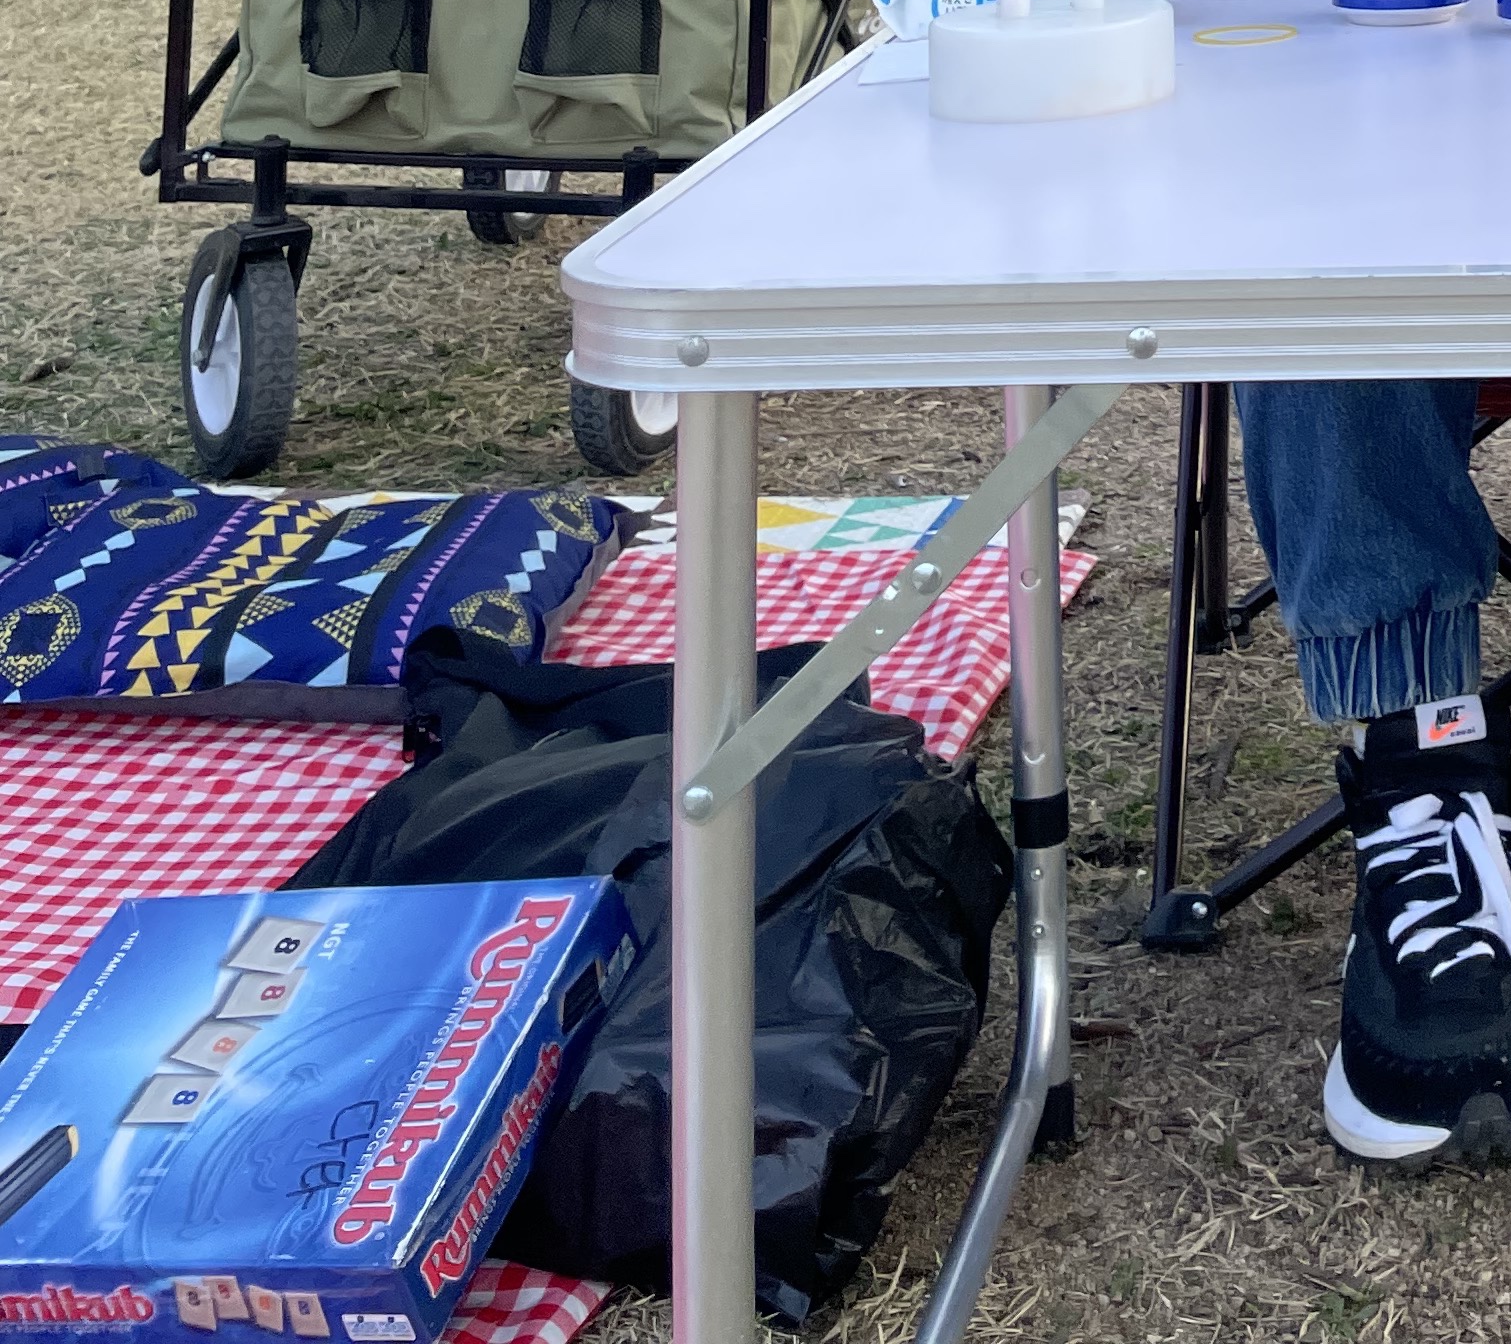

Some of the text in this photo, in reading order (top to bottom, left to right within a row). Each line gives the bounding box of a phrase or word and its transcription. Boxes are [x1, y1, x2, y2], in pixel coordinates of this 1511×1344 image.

[120, 929, 140, 951] THE
[274, 936, 301, 955] 8
[317, 922, 350, 961] NGT
[94, 952, 127, 988] FAMILY
[71, 987, 99, 1018] GAME
[260, 985, 286, 1001] 8
[44, 1018, 78, 1056] THAT'S
[212, 1036, 238, 1054] 8
[16, 1055, 50, 1092] NEVER
[332, 894, 574, 1246] Rummikub
[172, 1089, 199, 1106] 8
[331, 985, 473, 1207] BRINGS PEOPLE TOGETHER
[420, 1041, 563, 1299] Rummikub
[0, 1283, 155, 1324] mikub
